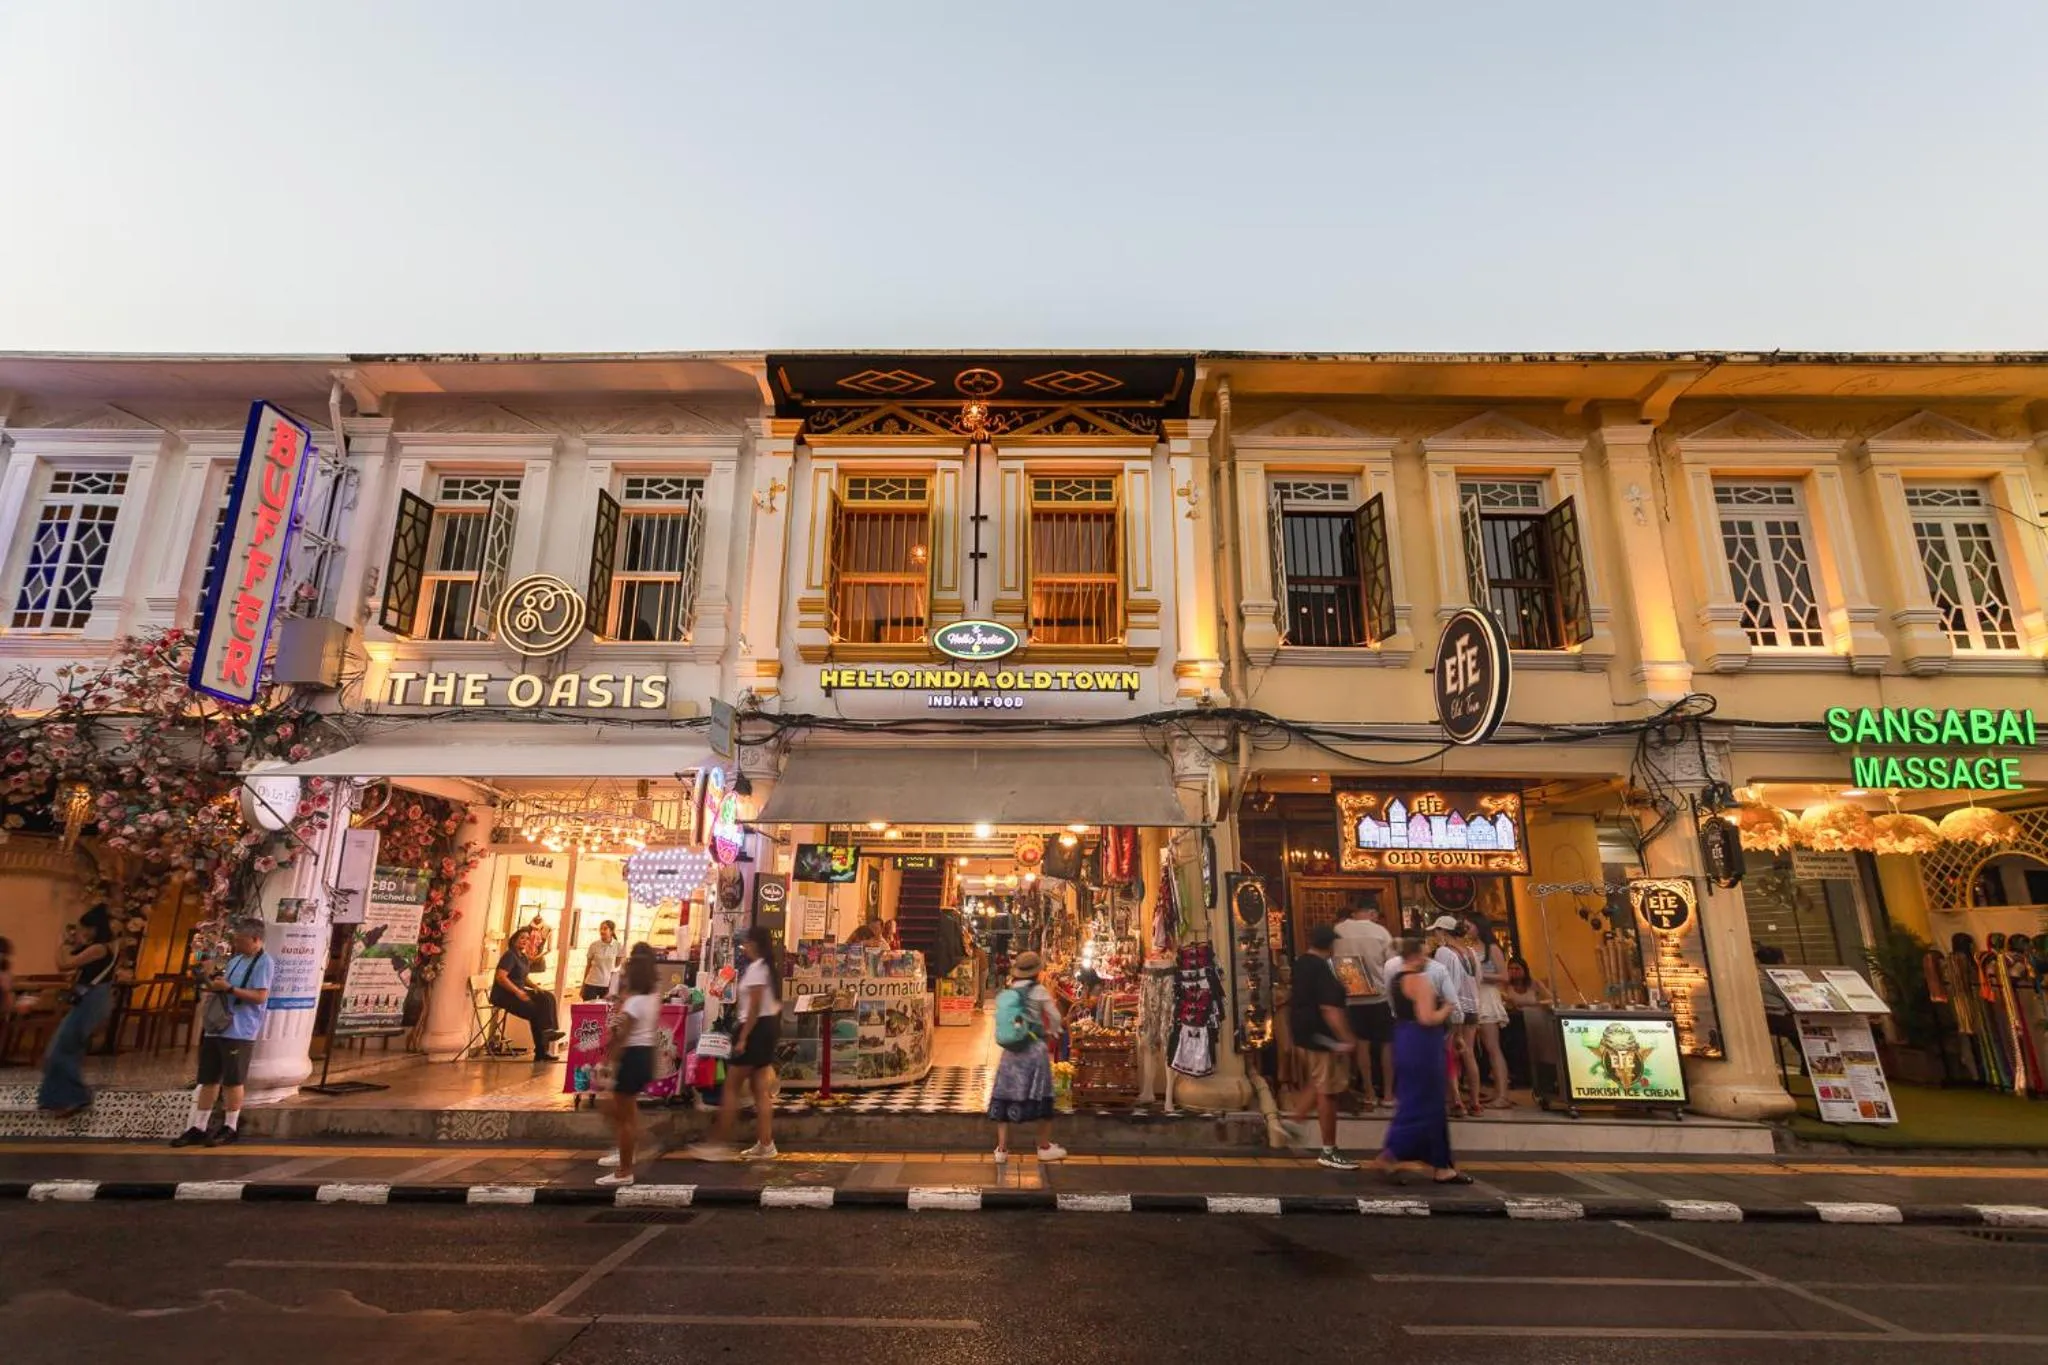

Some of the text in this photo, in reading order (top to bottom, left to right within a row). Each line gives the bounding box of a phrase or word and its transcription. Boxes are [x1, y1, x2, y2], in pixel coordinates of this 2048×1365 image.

[222, 418, 298, 689] BUFFER
[1444, 632, 1480, 695] EFE
[820, 669, 910, 689] HELLO
[914, 670, 990, 690] INDIA
[389, 671, 668, 708] THE OASIS
[928, 694, 1024, 708] INDIAN FOOD
[1827, 706, 2036, 745] SANSABAI
[1854, 756, 2024, 790] MASSAGE
[1417, 795, 1443, 813] EFE
[1387, 851, 1483, 865] OLD TOWN
[372, 879, 397, 892] CBD
[371, 892, 405, 902] nriched
[1649, 891, 1679, 910] EFE
[785, 978, 832, 996] Tour
[1609, 1050, 1636, 1069] EFE
[1576, 1086, 1681, 1098] TURKISH ICE CREAM
